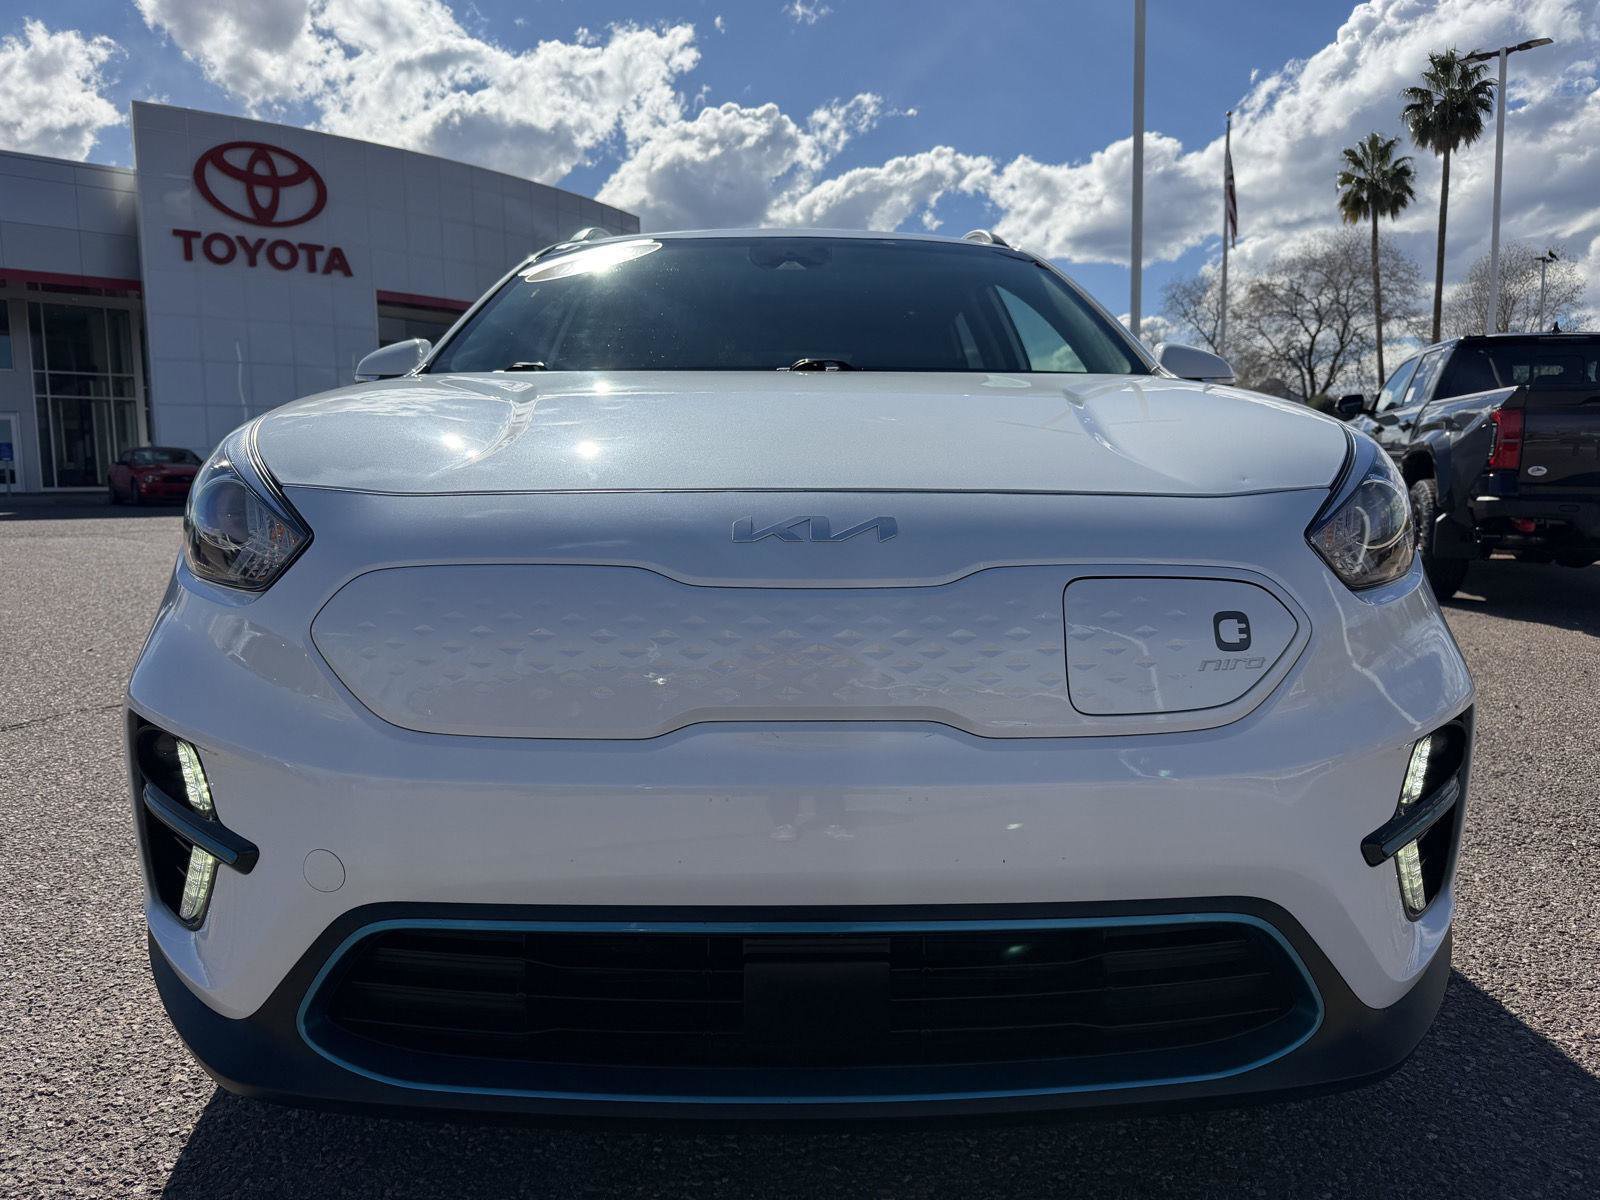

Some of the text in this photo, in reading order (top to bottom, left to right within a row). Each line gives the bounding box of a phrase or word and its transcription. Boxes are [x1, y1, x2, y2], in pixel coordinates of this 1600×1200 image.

[172, 228, 353, 277] TOYOTA
[732, 515, 898, 543] KIA
[1198, 657, 1266, 672] niro
